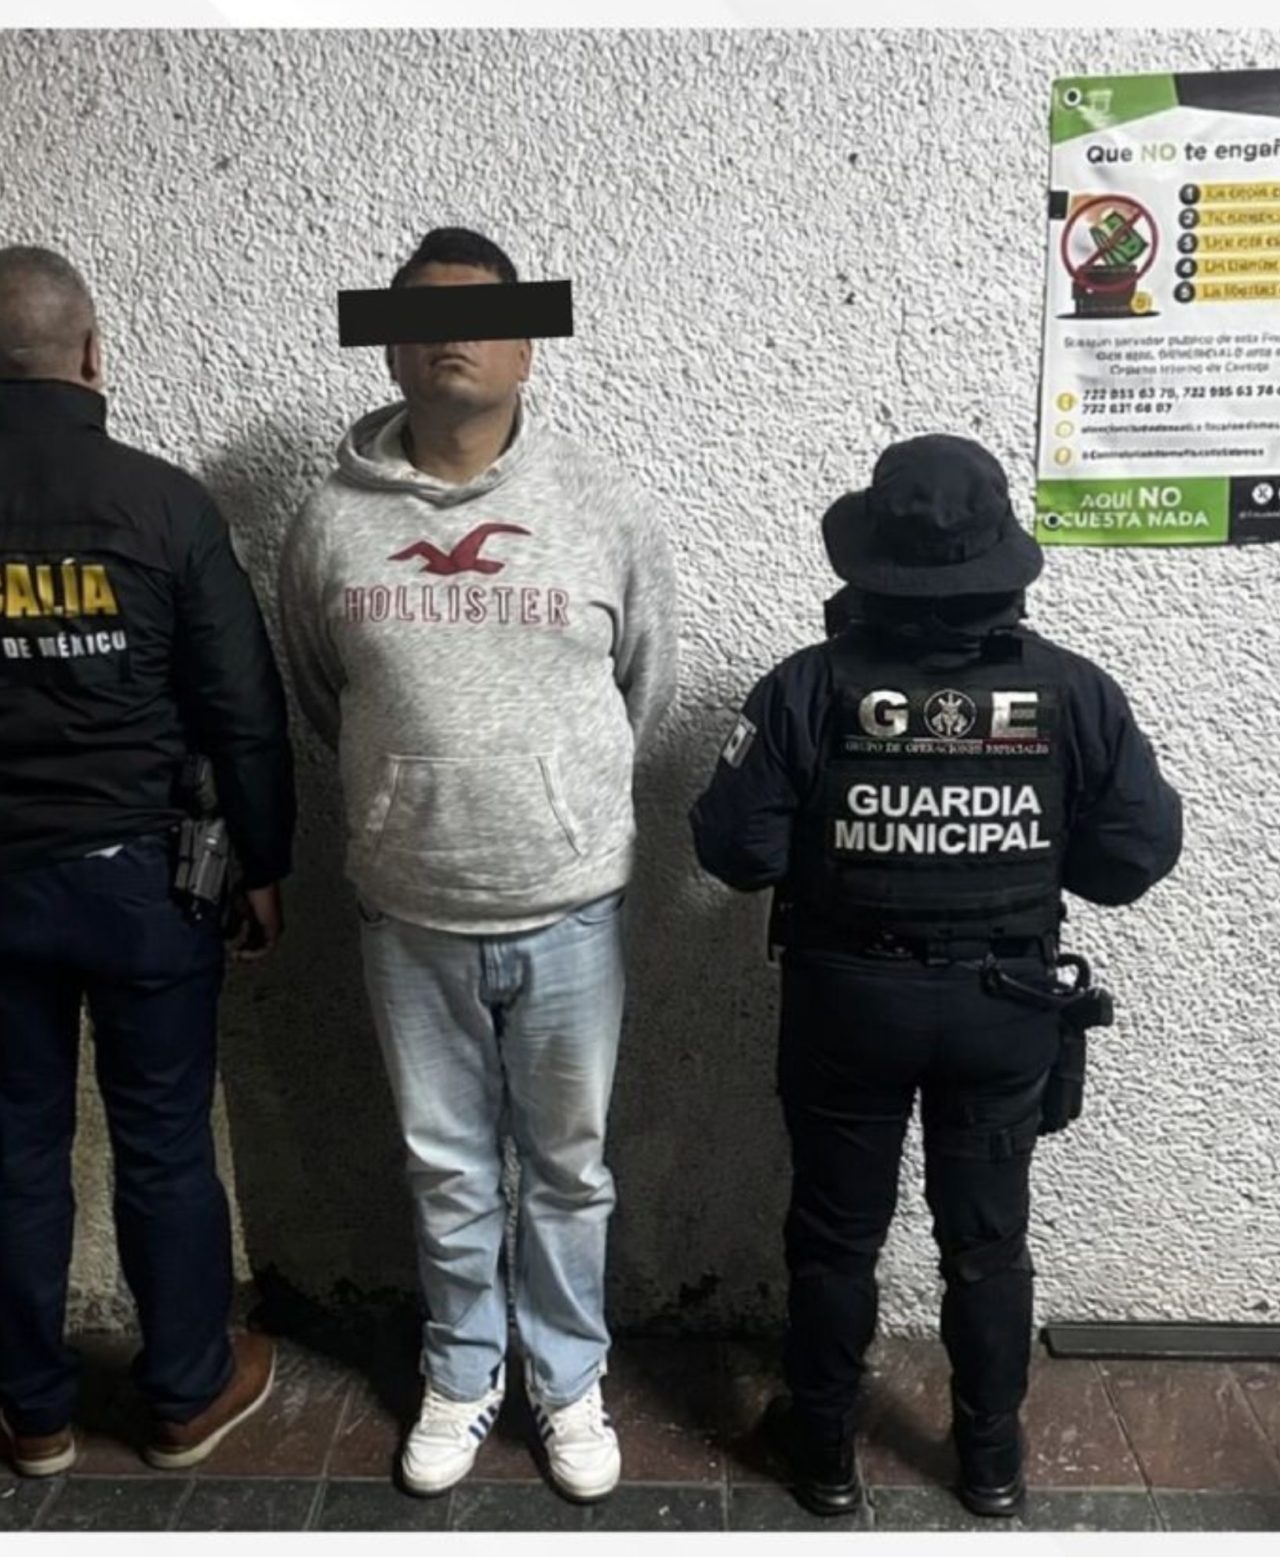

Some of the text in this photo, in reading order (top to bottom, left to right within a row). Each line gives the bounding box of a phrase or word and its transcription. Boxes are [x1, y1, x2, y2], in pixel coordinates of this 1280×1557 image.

[1086, 144, 1133, 165] Que
[1140, 143, 1177, 162] NO
[1184, 142, 1207, 161] te
[1081, 486, 1182, 509] AQUÍ NO
[1148, 510, 1210, 528] NADA
[0, 557, 118, 617] ALÍA
[344, 584, 570, 626] HOLLISTER
[2, 636, 32, 659] DE
[847, 783, 1042, 817] GUARDIA
[835, 819, 1050, 854] MUNICIPAL
